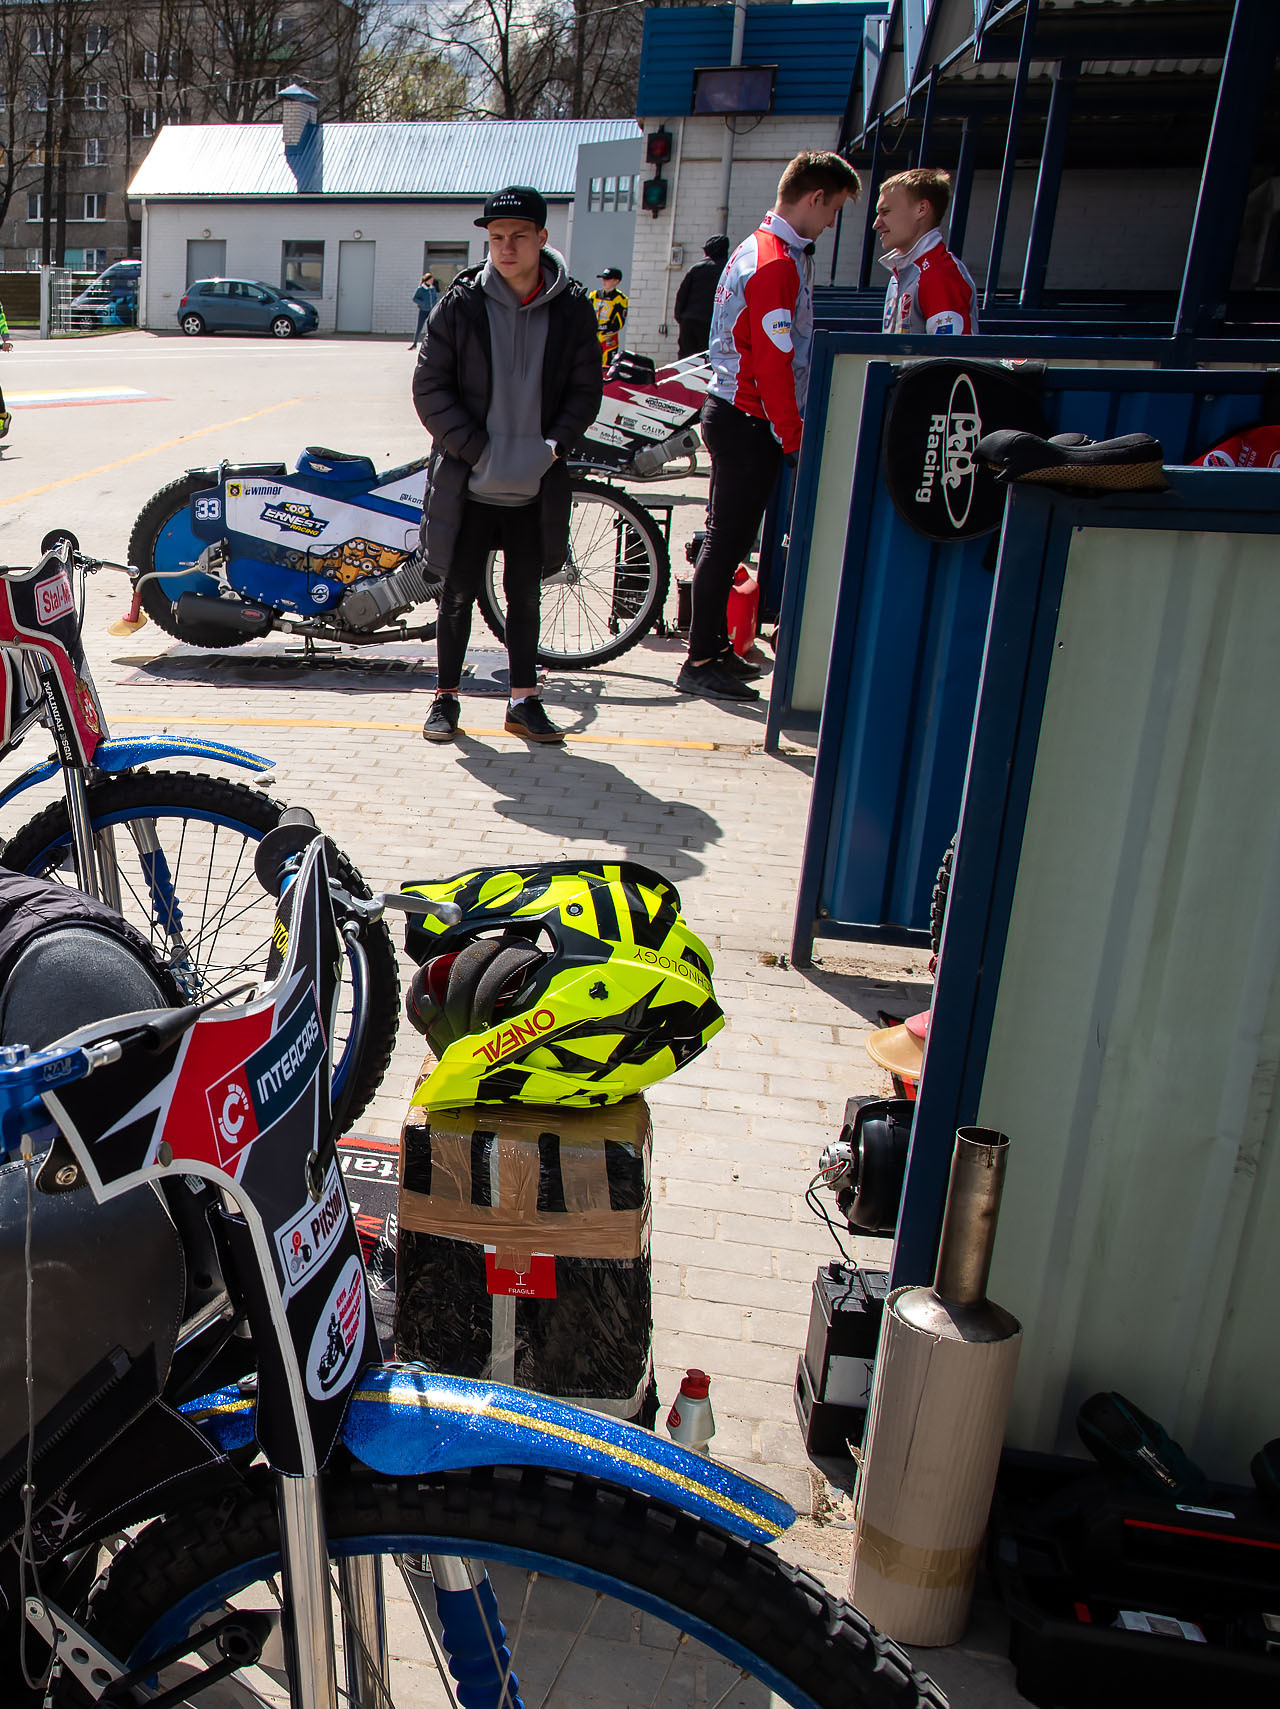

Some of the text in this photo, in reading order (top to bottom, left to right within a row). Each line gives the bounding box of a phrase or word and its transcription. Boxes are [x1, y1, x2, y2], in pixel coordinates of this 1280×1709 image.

[914, 414, 947, 503] Racing
[196, 498, 221, 520] 33
[264, 508, 325, 529] ERNEST
[290, 523, 320, 536] RACING
